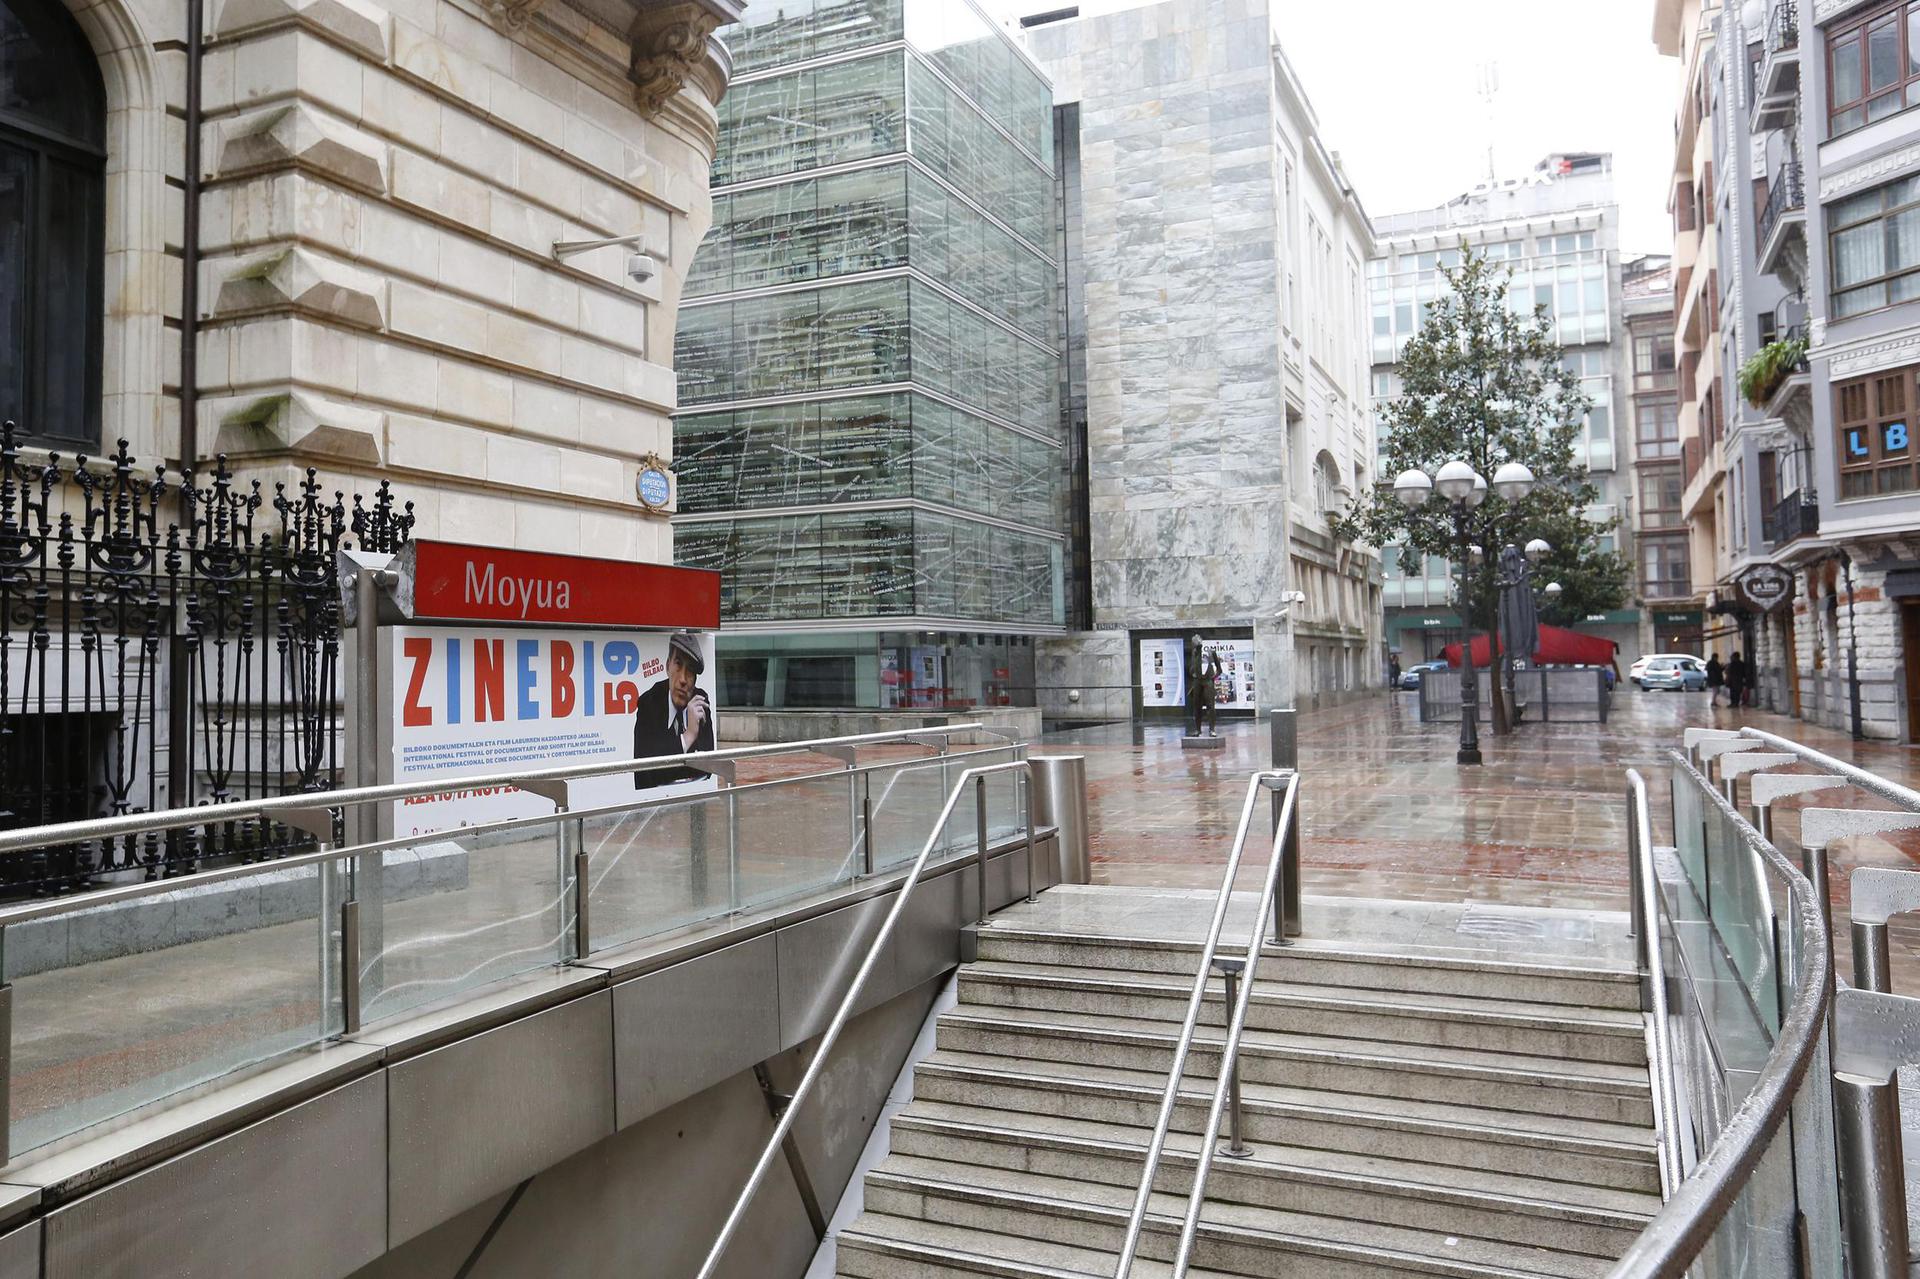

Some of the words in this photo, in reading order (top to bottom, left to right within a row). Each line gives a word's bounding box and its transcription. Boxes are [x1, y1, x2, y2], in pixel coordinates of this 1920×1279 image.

[464, 560, 571, 618] Moyua
[642, 658, 660, 670] BILBO
[643, 664, 664, 678] BILBAO
[402, 637, 595, 727] ZINEBI
[603, 640, 640, 715] 59
[403, 744, 432, 753] BILBOKO
[433, 740, 484, 751] DOKUMENTALEN
[484, 739, 496, 747] ETA
[497, 738, 511, 746] FILM
[511, 736, 540, 746] LABURREN
[541, 734, 577, 744] NAZIOARTEKO
[578, 732, 600, 740] JAIALDIA
[404, 752, 454, 762] INTERNATIONAL
[455, 750, 483, 760] FESTIVAL
[483, 748, 494, 756] OF
[494, 745, 537, 755] DOCUMENTARY
[537, 744, 549, 752] AND
[549, 742, 567, 750] SHORT
[567, 741, 580, 749] FILM
[580, 740, 588, 748] OF
[588, 739, 605, 747] BILBAO
[404, 762, 436, 772] FESTIVAL
[436, 758, 485, 769] INTERNACIONAL
[486, 756, 494, 764] DE
[494, 756, 508, 764] CINE
[508, 752, 546, 762] DOCUMENTAL
[551, 748, 592, 758] CORTOMETRAJE
[598, 746, 616, 754] BILBAO
